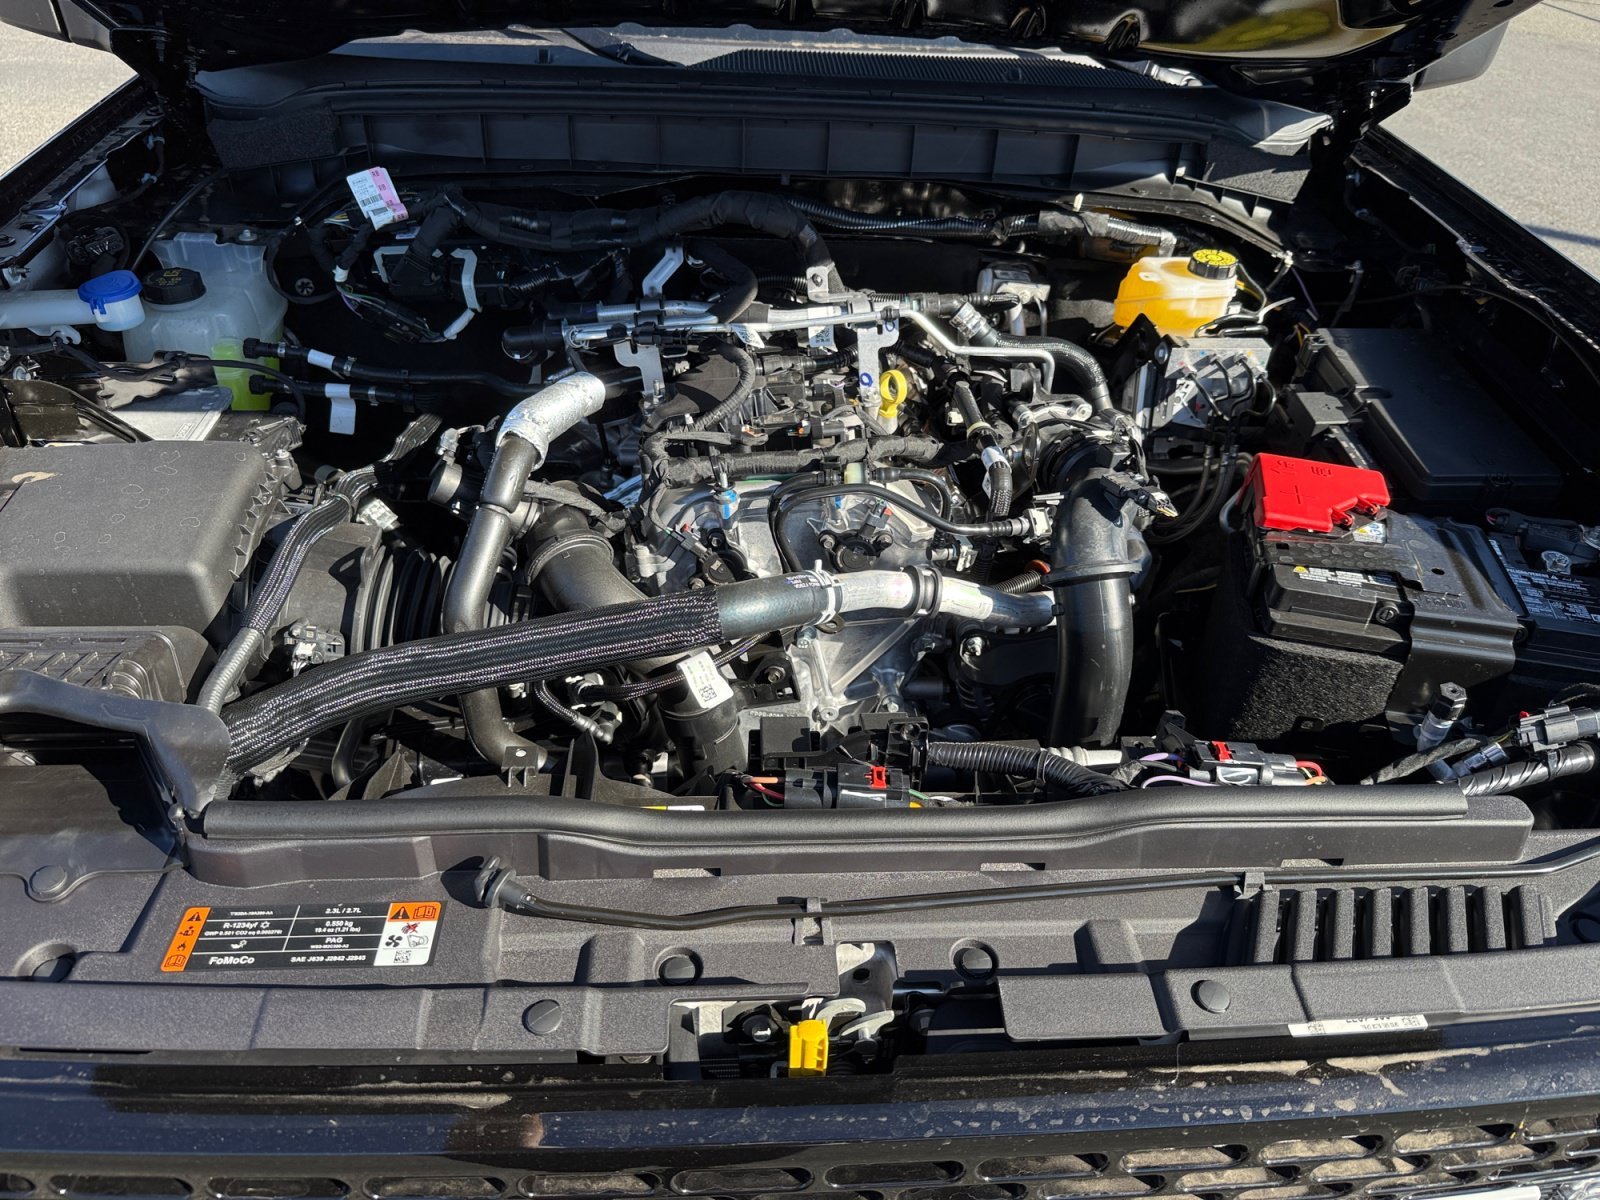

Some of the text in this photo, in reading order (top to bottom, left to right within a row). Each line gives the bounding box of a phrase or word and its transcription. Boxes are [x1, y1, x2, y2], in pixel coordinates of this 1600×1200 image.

[223, 921, 259, 930] R-1234yf
[344, 920, 353, 928] kg
[208, 955, 255, 965] FoMoCo
